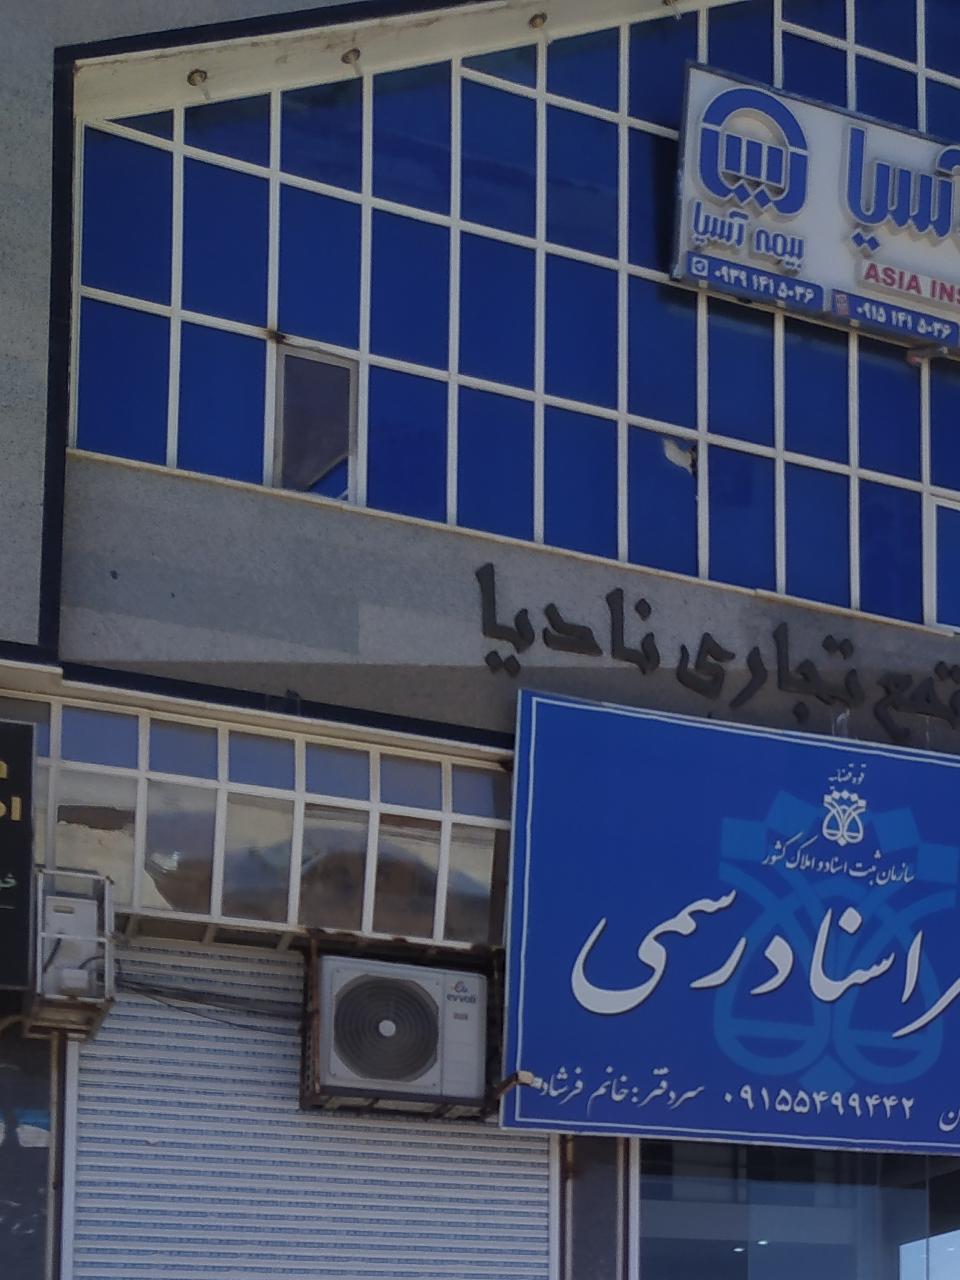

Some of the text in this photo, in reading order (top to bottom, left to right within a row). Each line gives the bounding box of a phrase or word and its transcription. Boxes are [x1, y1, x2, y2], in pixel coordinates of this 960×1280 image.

[693, 201, 805, 269] بیمه آسیا
[864, 262, 922, 295] ASIA
[474, 562, 661, 678] نادیا
[676, 622, 867, 724] تجاری
[762, 832, 803, 864] کشور
[785, 835, 818, 869] املاک
[825, 857, 847, 874] اسناد
[850, 850, 882, 886] ثبت
[875, 863, 914, 885] سازمان
[570, 888, 748, 1016] رسمی
[750, 907, 924, 1005] اسناد
[586, 1065, 629, 1117] خانم
[723, 1084, 915, 1120] ۰۹۱۵۵۴۹۹۴۴۲
